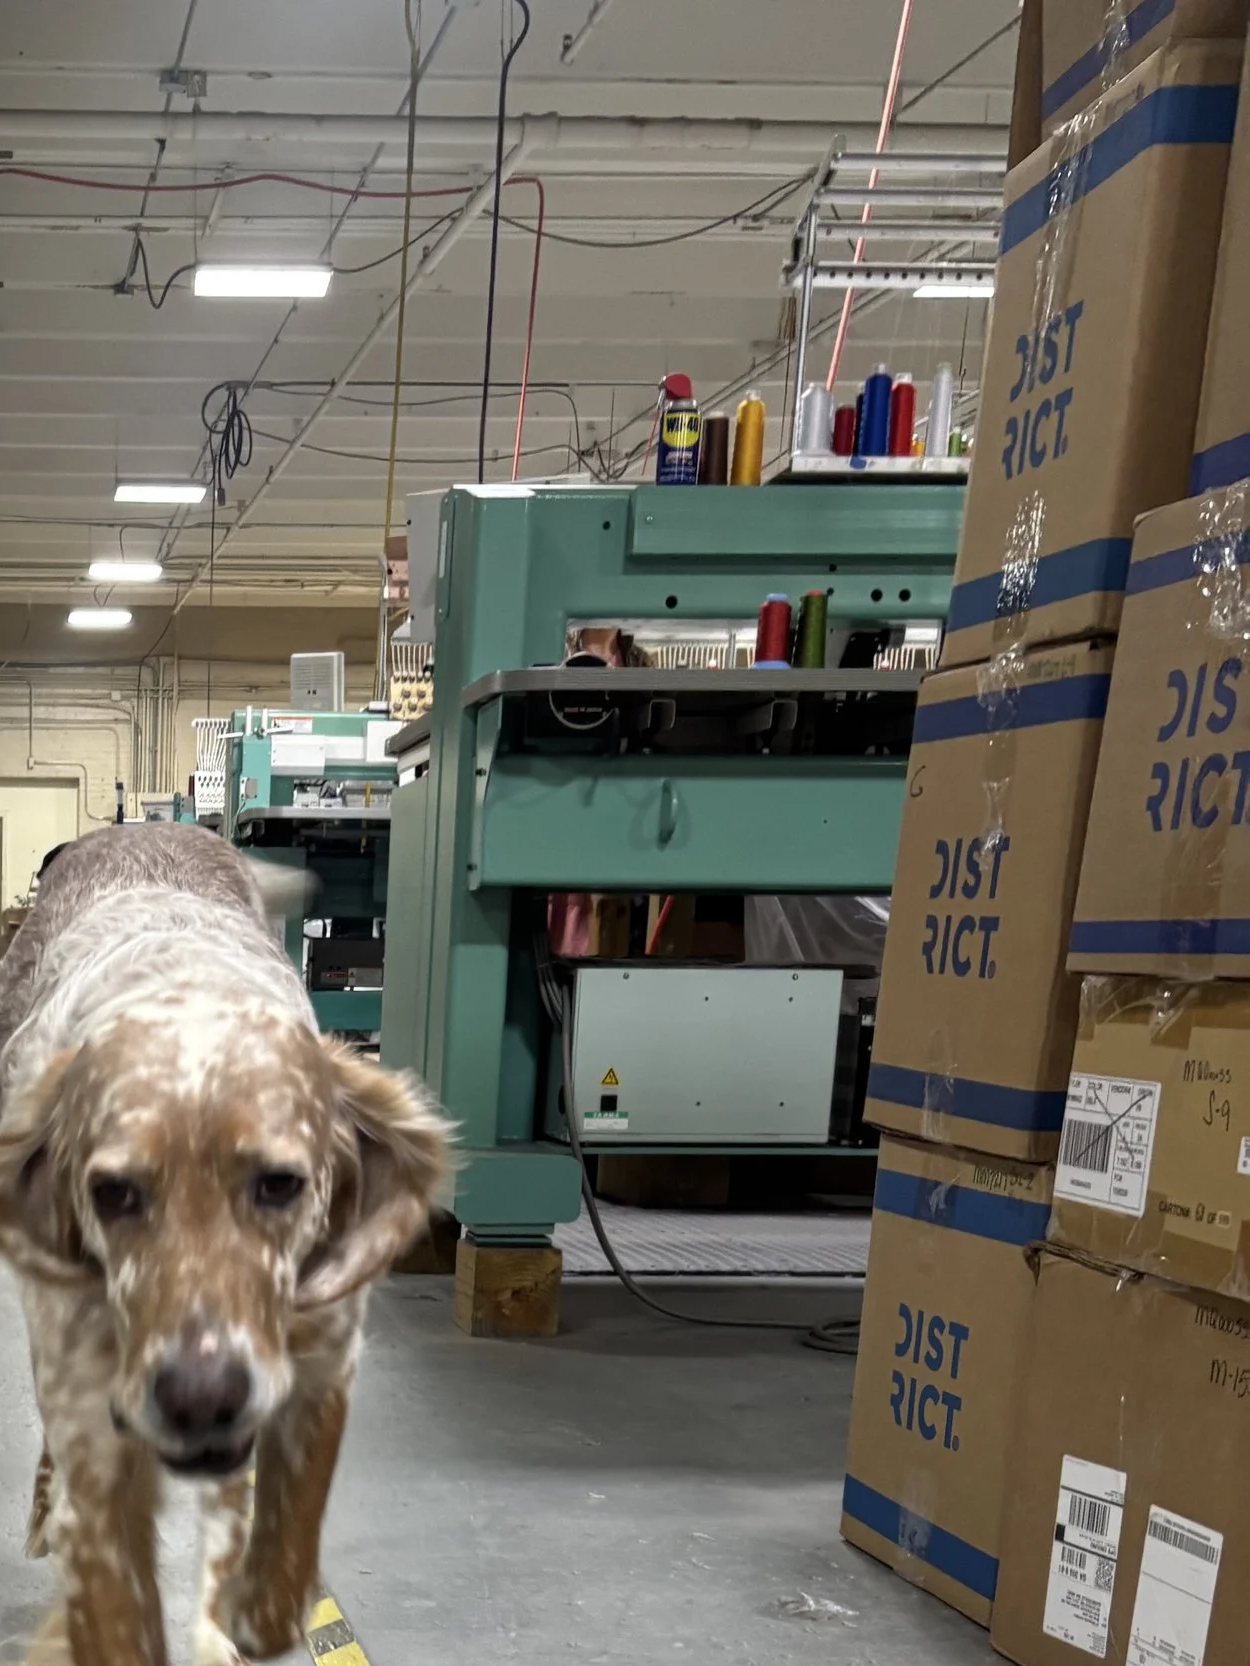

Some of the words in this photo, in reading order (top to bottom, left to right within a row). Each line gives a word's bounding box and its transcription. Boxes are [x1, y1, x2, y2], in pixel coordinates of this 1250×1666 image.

[1009, 300, 1084, 402] DIST
[930, 836, 1010, 900] DIST
[894, 1303, 970, 1380] DIST
